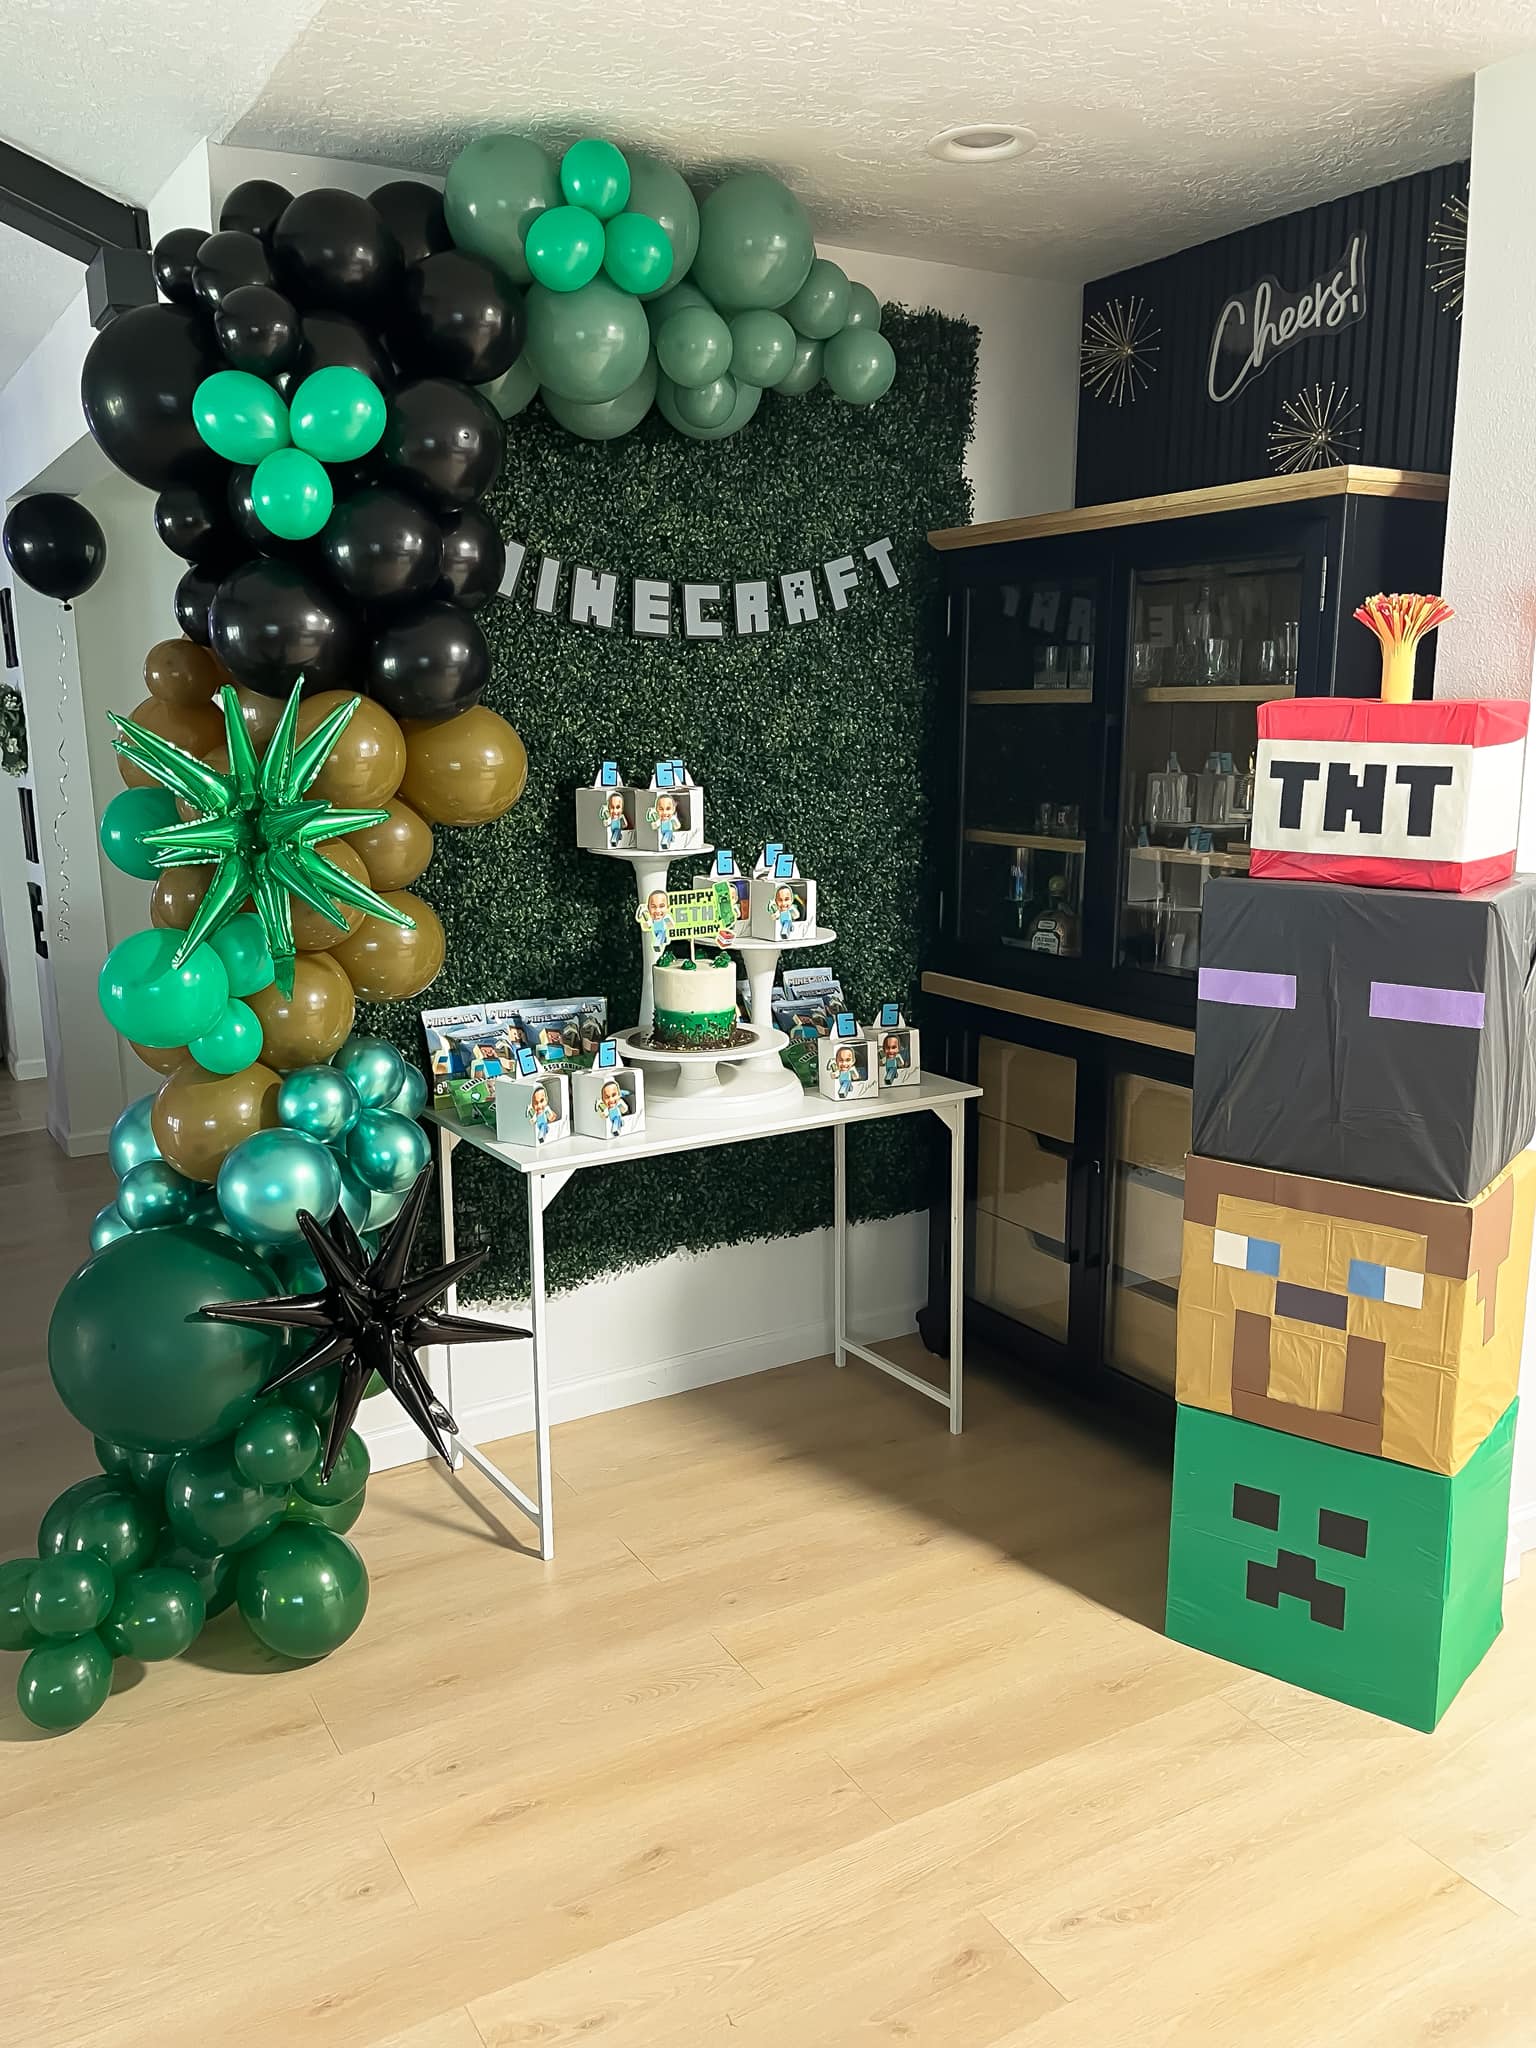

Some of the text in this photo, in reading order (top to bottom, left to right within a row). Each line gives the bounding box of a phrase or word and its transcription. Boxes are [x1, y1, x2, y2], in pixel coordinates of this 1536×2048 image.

[1208, 237, 1360, 402] Cheers!
[601, 760, 618, 787] 6
[1270, 760, 1453, 837] TNT
[717, 849, 734, 876] 6
[774, 853, 795, 879] 6
[669, 890, 715, 905] HAPPY
[675, 906, 714, 923] 6TH
[669, 924, 721, 938] BIRTHDAY
[836, 1012, 858, 1038] 6
[881, 1003, 900, 1027] 6
[516, 1047, 539, 1076] 6
[598, 1039, 617, 1068] 6
